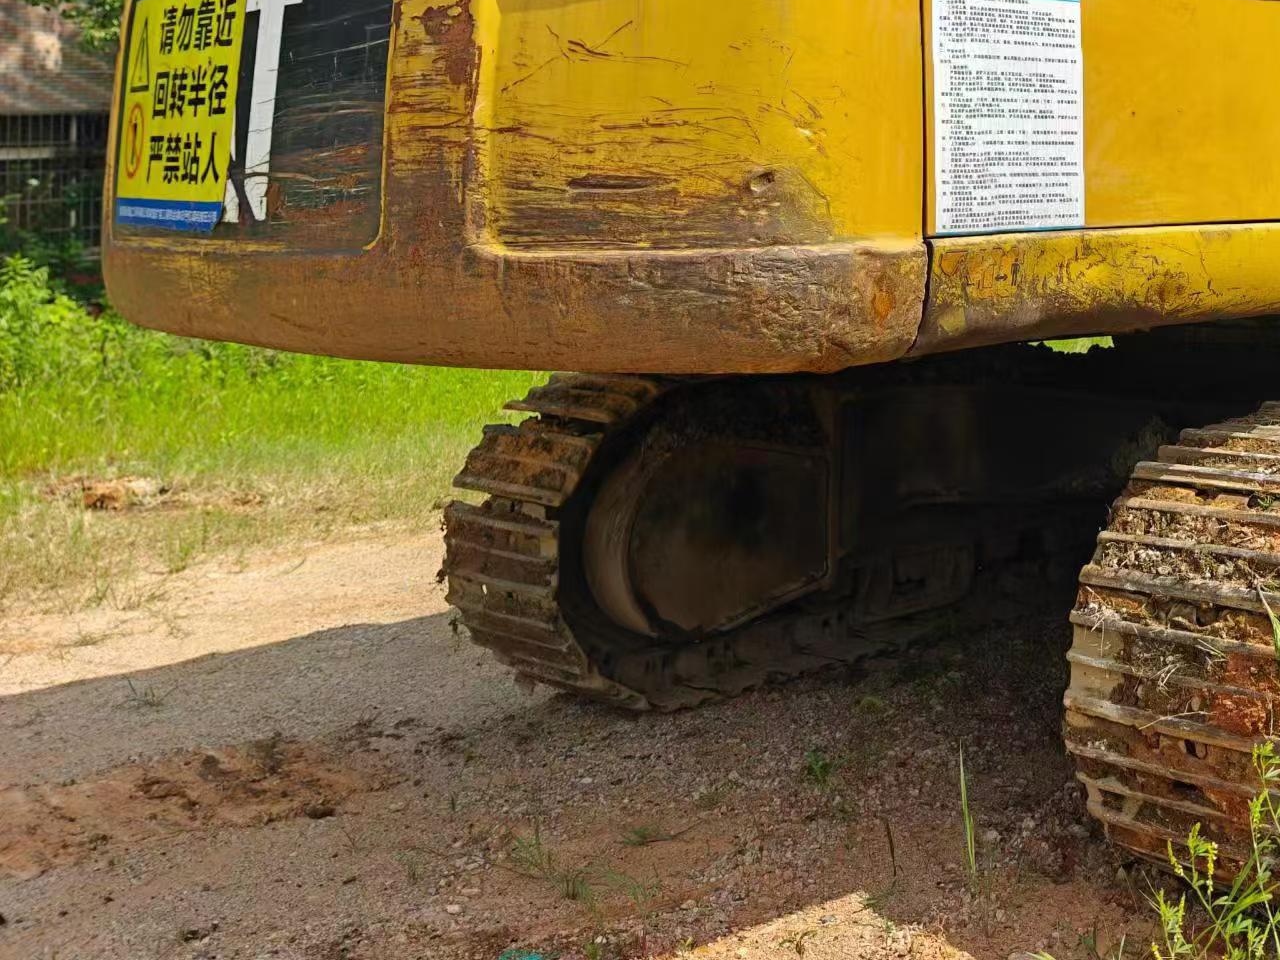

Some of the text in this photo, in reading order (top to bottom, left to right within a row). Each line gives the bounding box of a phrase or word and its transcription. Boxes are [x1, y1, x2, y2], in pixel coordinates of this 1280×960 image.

[151, 65, 229, 121] 回转半径
[146, 132, 220, 184] 严禁站人
